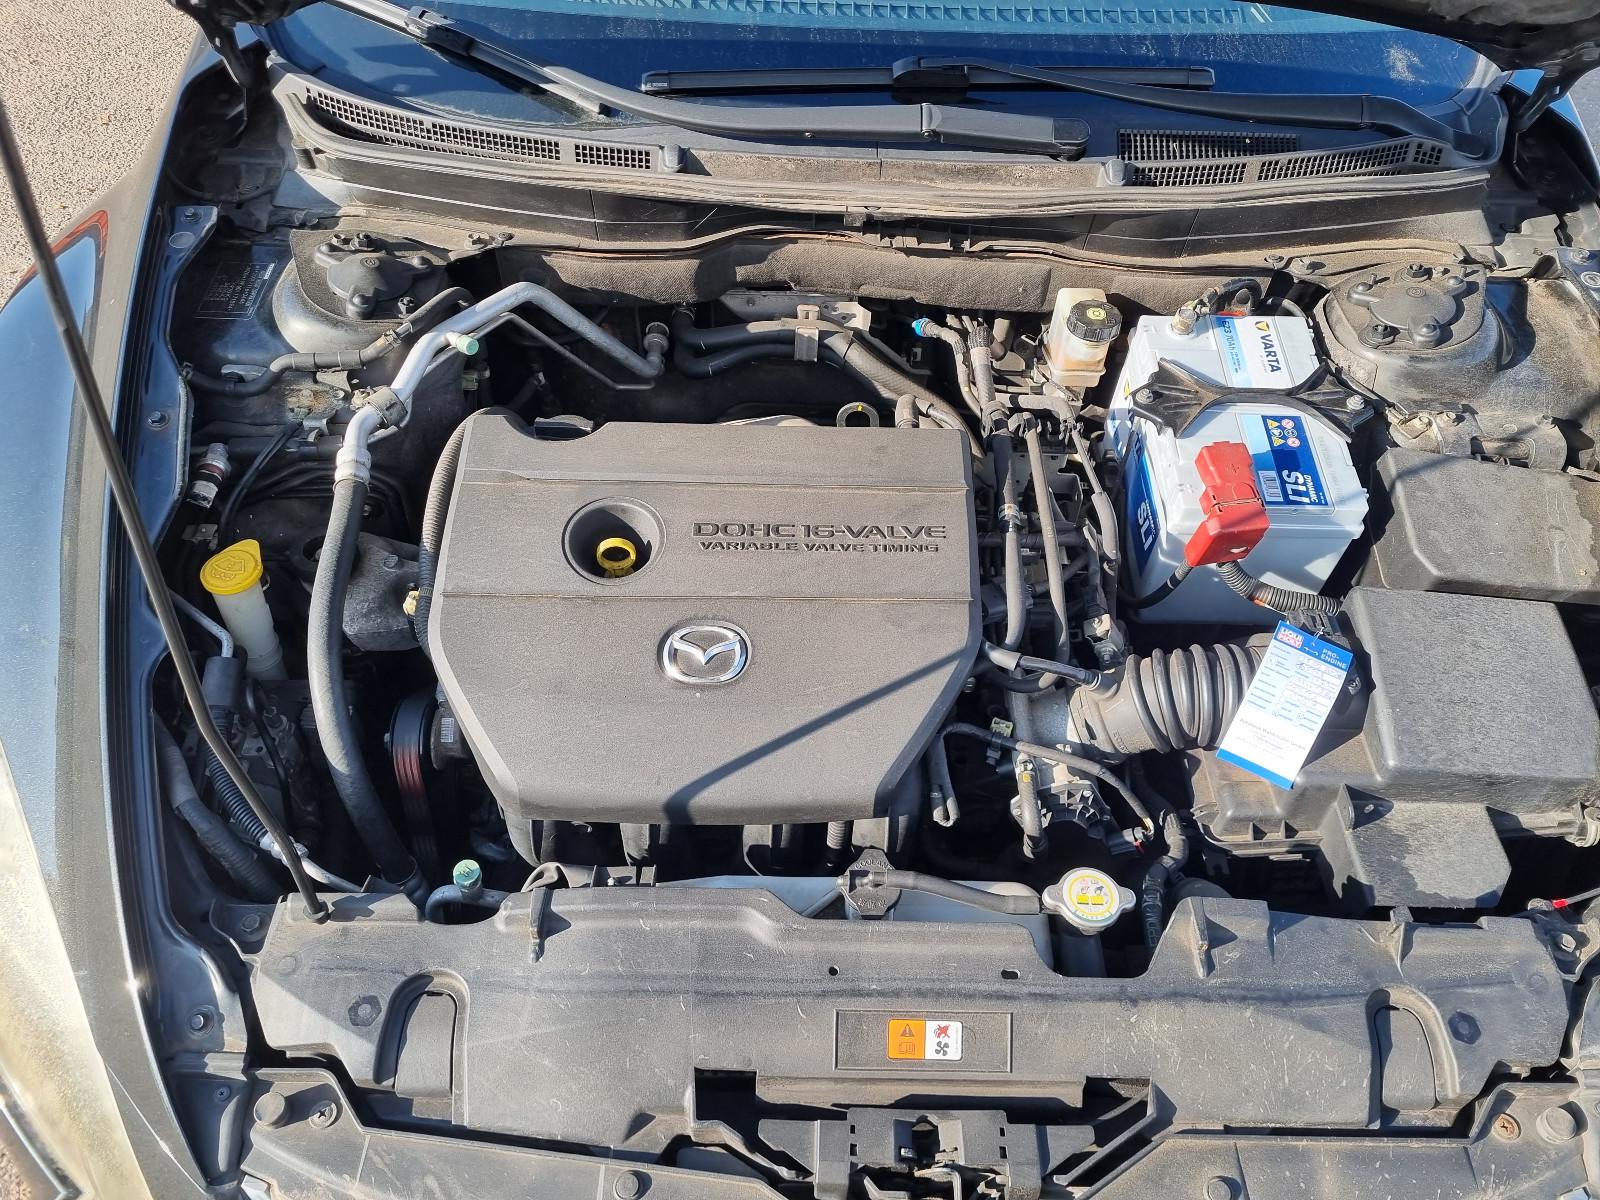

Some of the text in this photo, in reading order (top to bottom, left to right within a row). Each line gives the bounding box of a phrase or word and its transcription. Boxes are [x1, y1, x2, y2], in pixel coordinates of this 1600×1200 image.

[1260, 334, 1281, 373] VARTA
[1282, 469, 1311, 504] SLI
[1304, 474, 1319, 503] DYNAMIC
[693, 522, 947, 540] DOHC 16-VALVE
[1137, 501, 1153, 551] SLI
[699, 541, 939, 553] VARIABLE VALVE TIMING
[1280, 627, 1304, 642] LIQUI
[1320, 654, 1347, 669] ENGINE
[1322, 648, 1340, 660] PRO-
